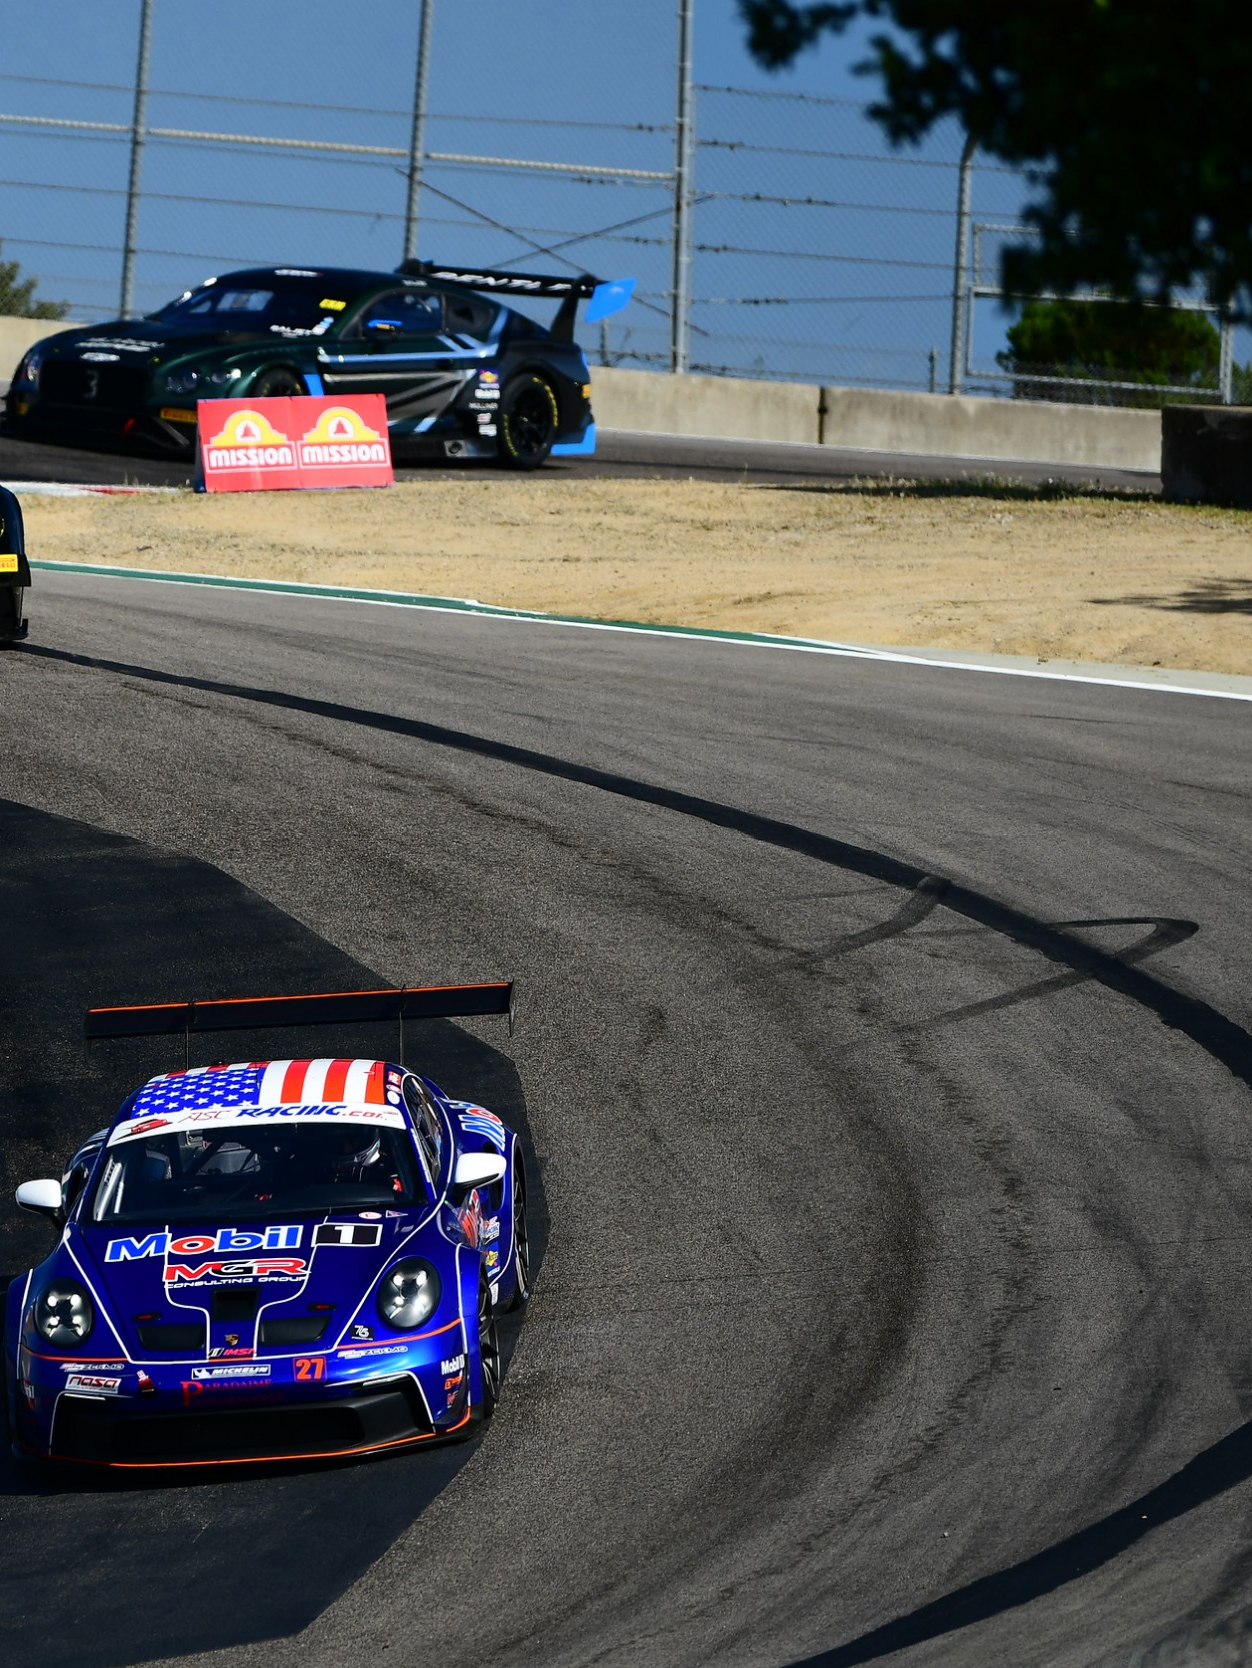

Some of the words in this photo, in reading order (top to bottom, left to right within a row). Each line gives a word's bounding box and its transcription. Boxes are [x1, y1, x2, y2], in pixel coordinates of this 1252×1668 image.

[209, 446, 293, 467] MISSION
[303, 443, 385, 464] MISSION
[104, 1225, 303, 1262] Mobil
[333, 1224, 356, 1244] 1
[163, 1258, 311, 1282] MGR
[164, 1277, 254, 1289] CONSULTING
[212, 1366, 269, 1376] MICHELIN
[296, 1358, 324, 1380] 27
